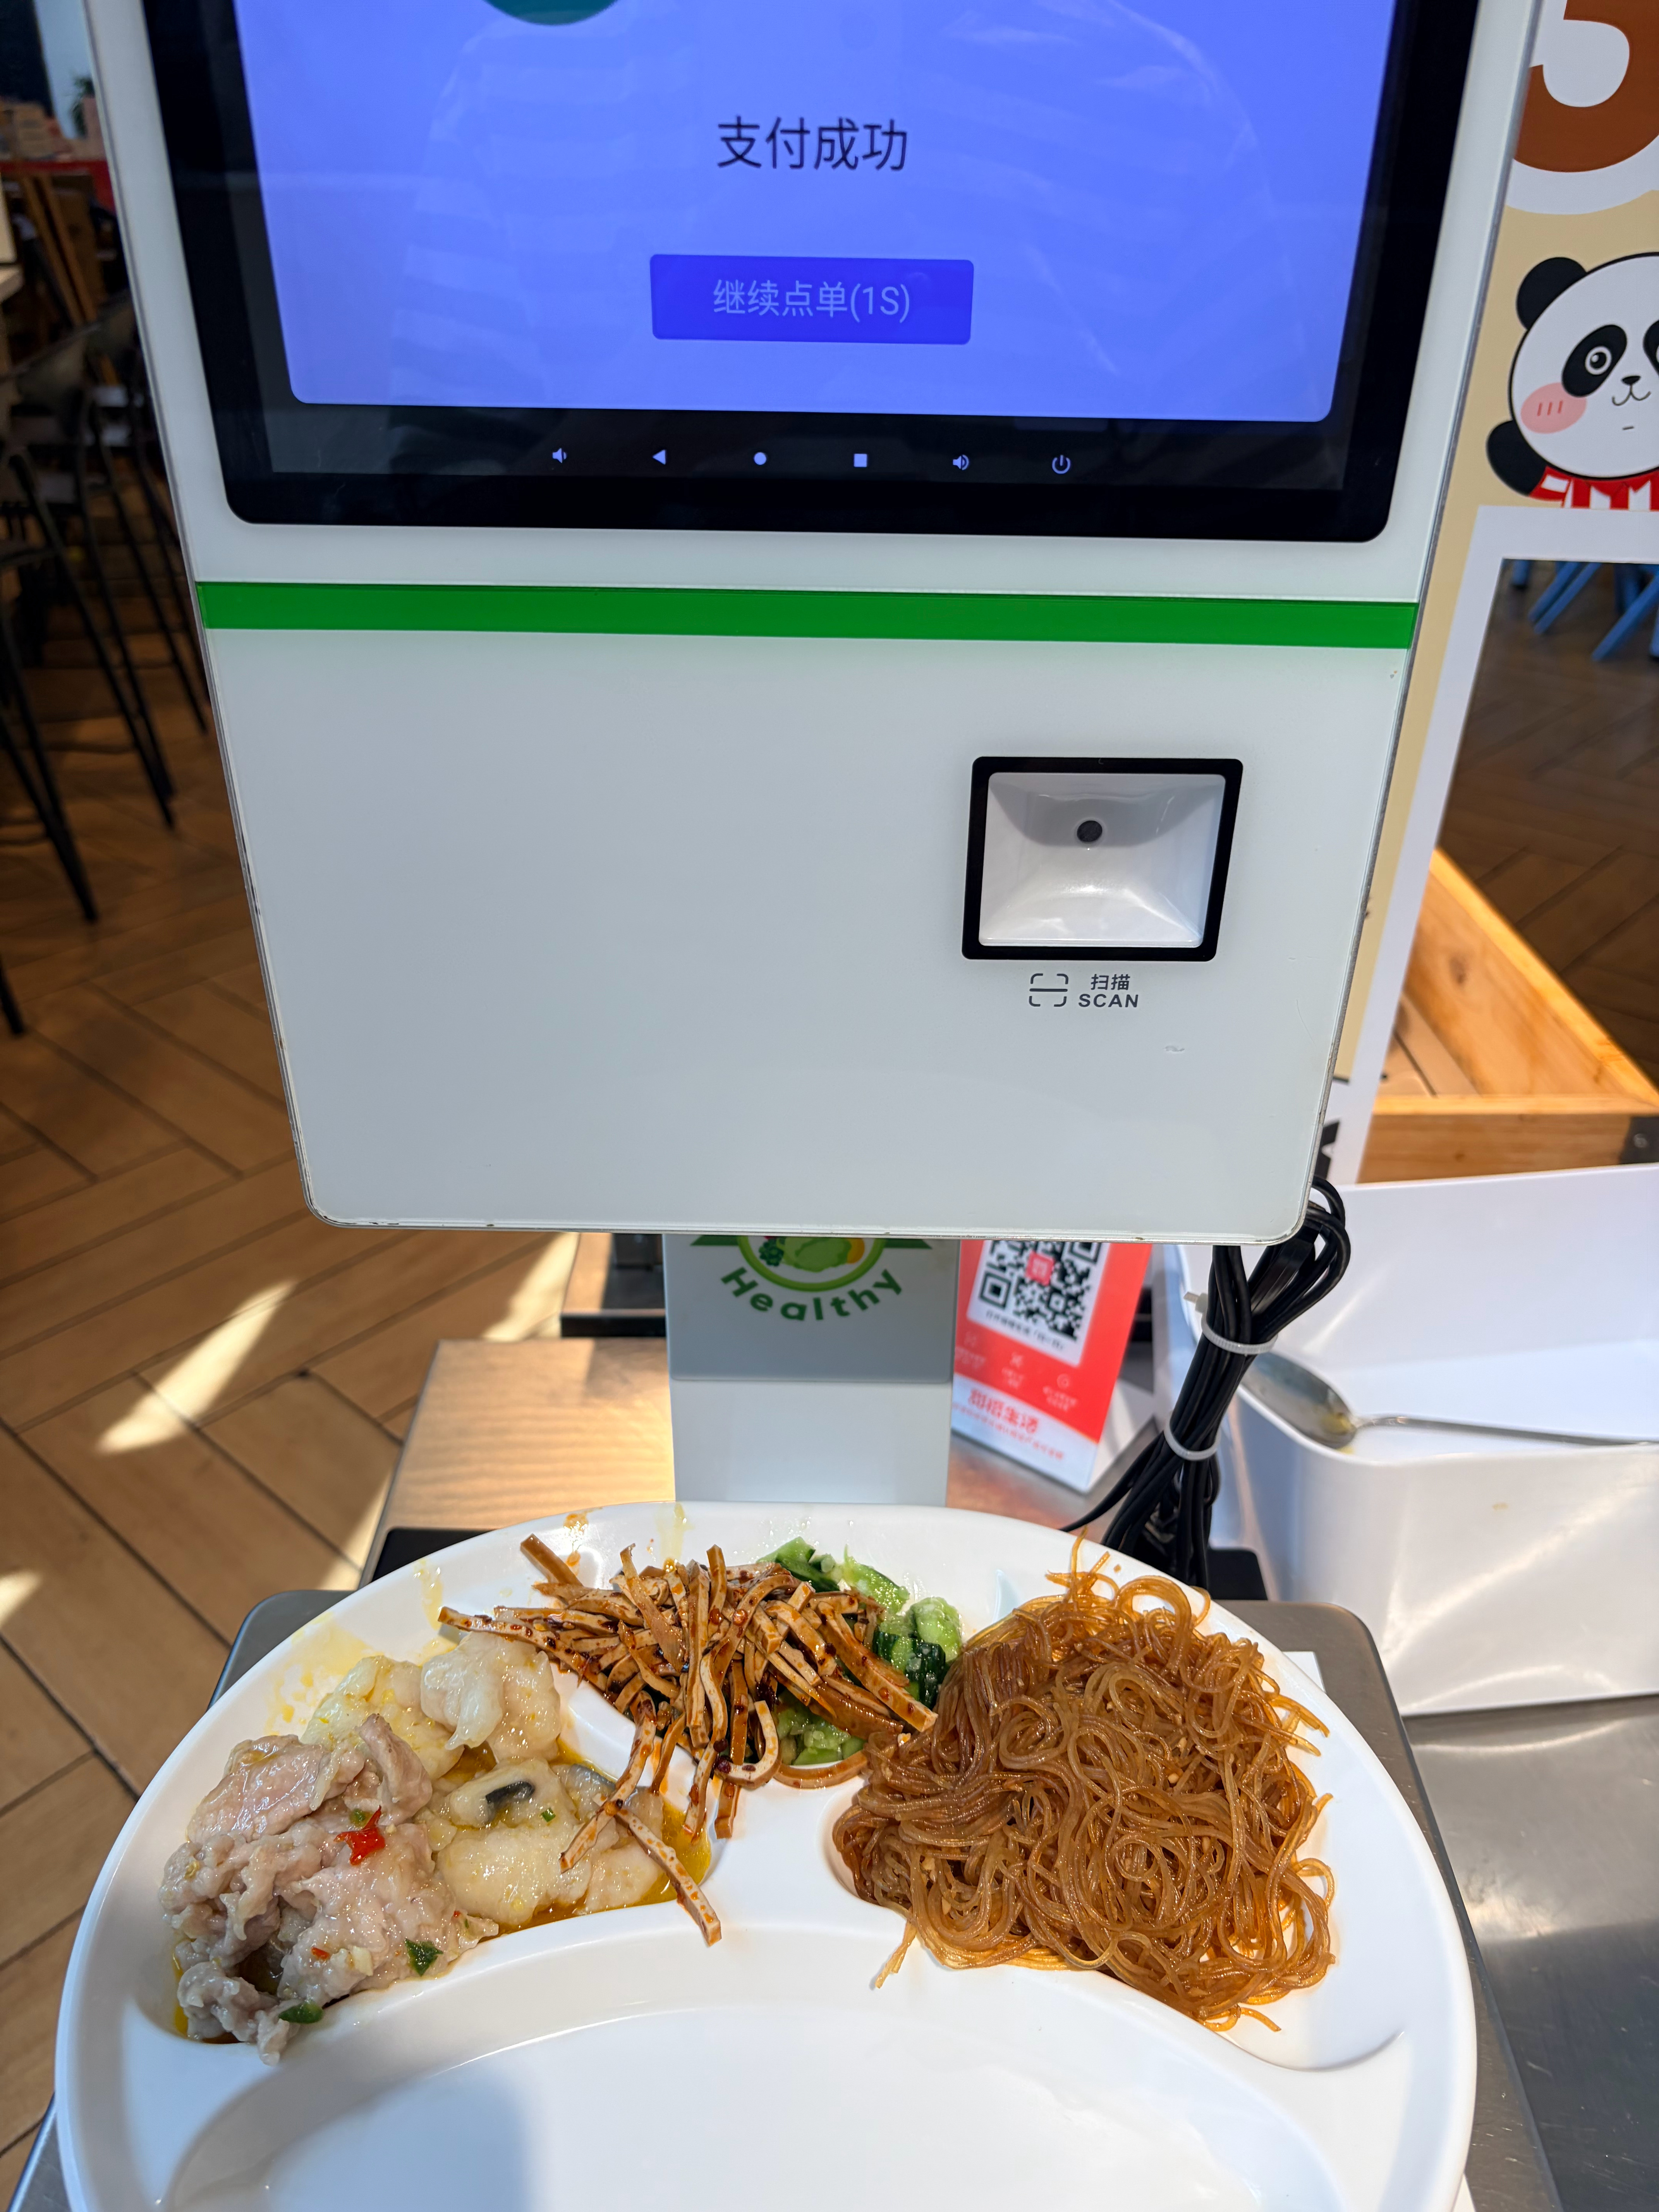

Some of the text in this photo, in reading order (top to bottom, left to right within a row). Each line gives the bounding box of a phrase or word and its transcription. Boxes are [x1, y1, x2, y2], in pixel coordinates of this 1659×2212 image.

[716, 114, 908, 171] 支付成功
[713, 279, 910, 323] 继续点单(1S)
[1078, 993, 1139, 1008] SCAN
[1090, 973, 1131, 991] 扫描
[720, 1266, 902, 1321] Healthy
